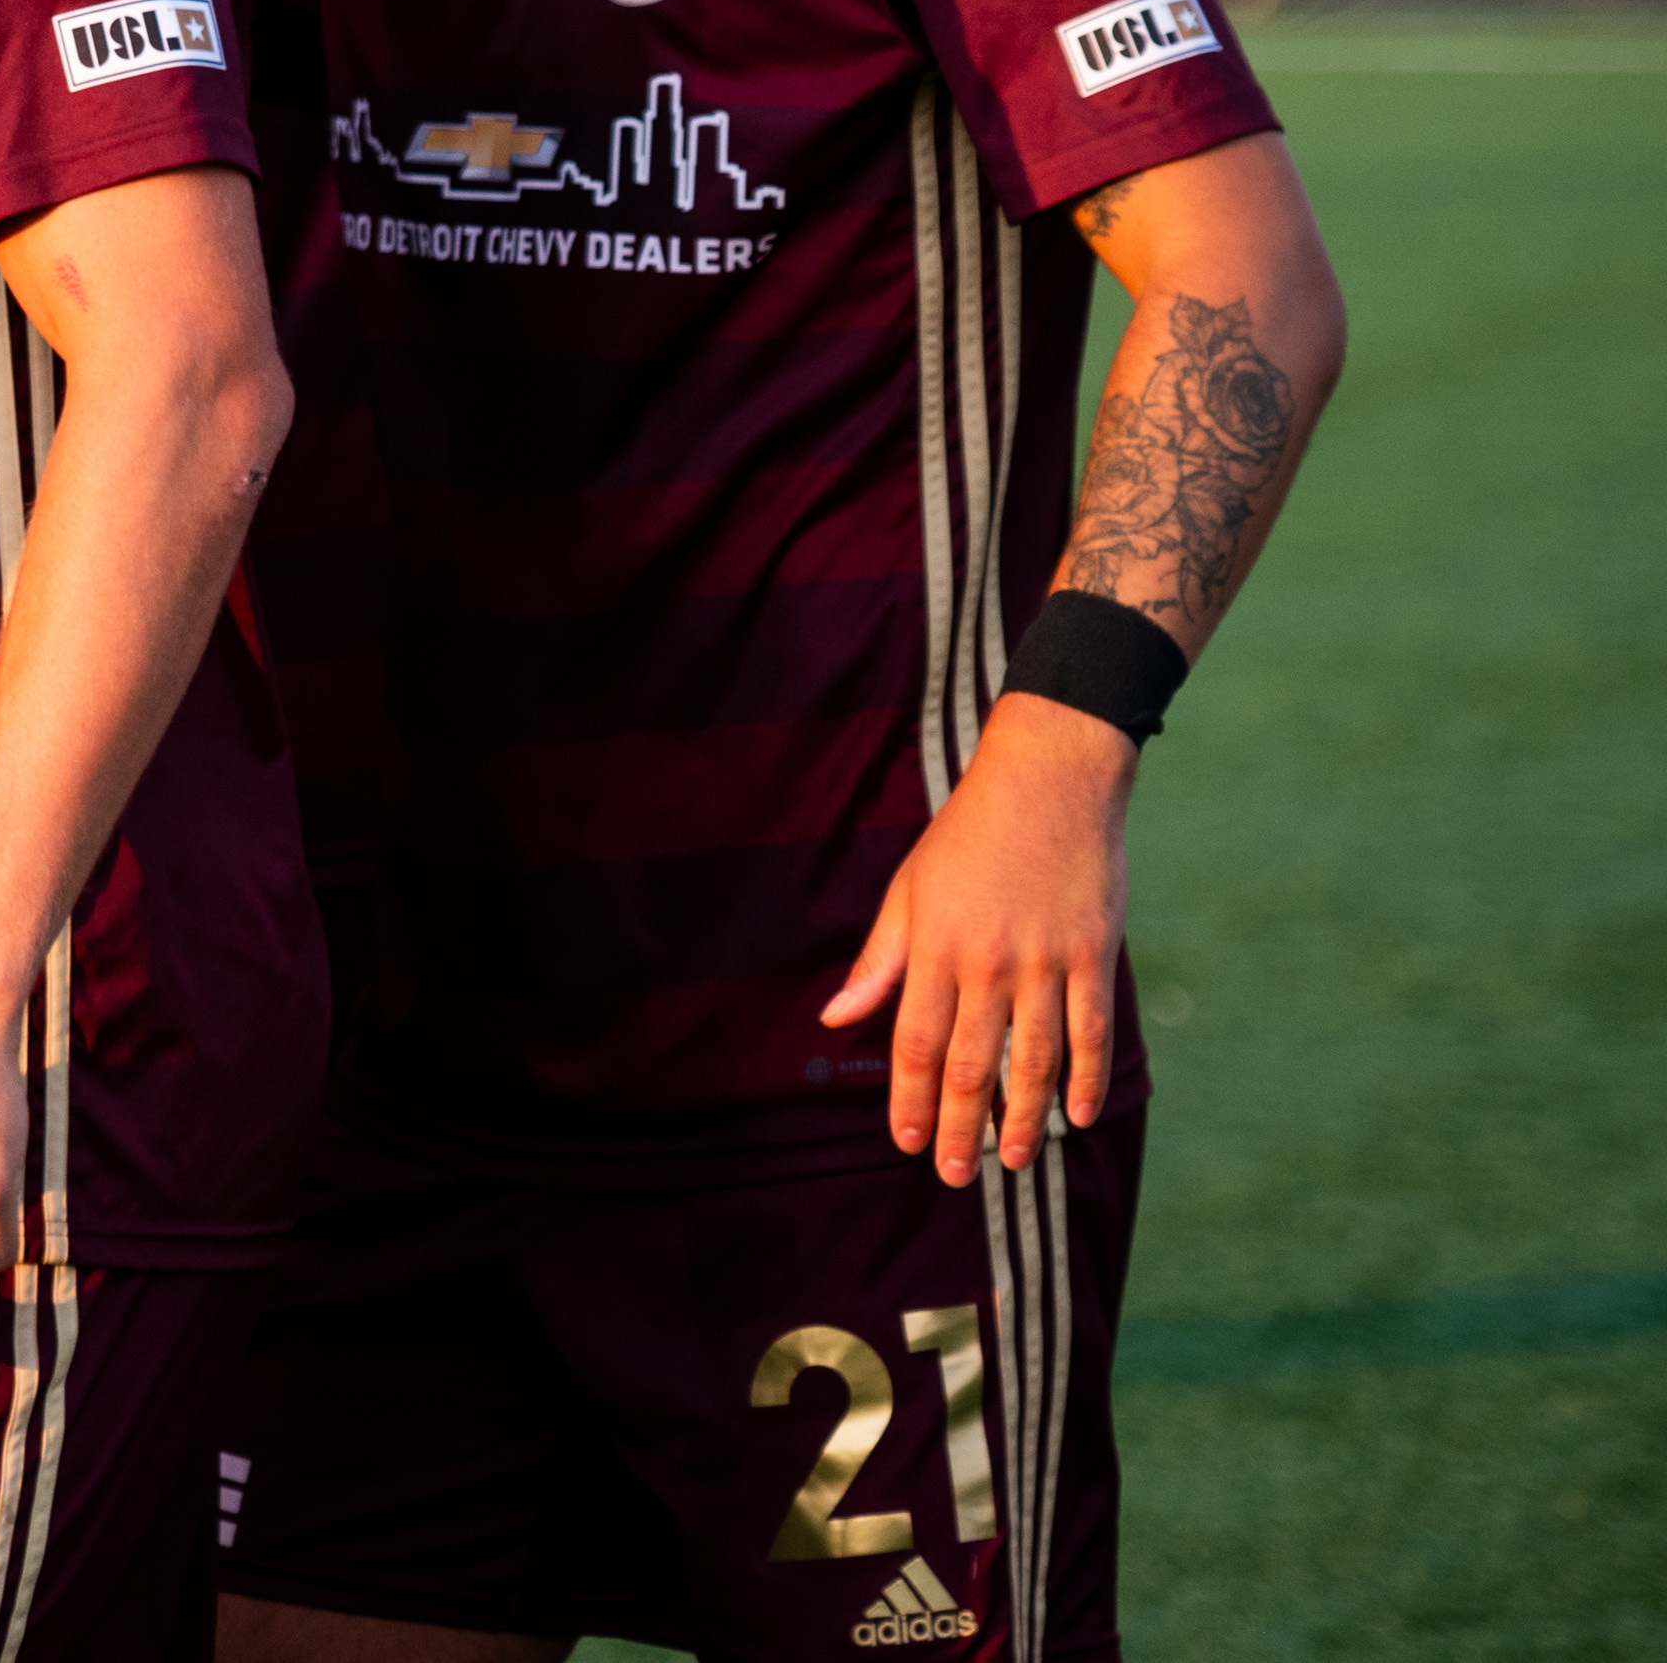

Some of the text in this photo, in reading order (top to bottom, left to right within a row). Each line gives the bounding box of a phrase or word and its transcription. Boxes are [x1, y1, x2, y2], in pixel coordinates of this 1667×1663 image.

[72, 10, 181, 69] USL
[1078, 9, 1179, 72] USL
[376, 215, 483, 263] DETROIT
[485, 224, 576, 267] CHEVY
[584, 229, 779, 275] DEALERS
[750, 1303, 998, 1562] 21
[851, 1609, 979, 1648] adidas
